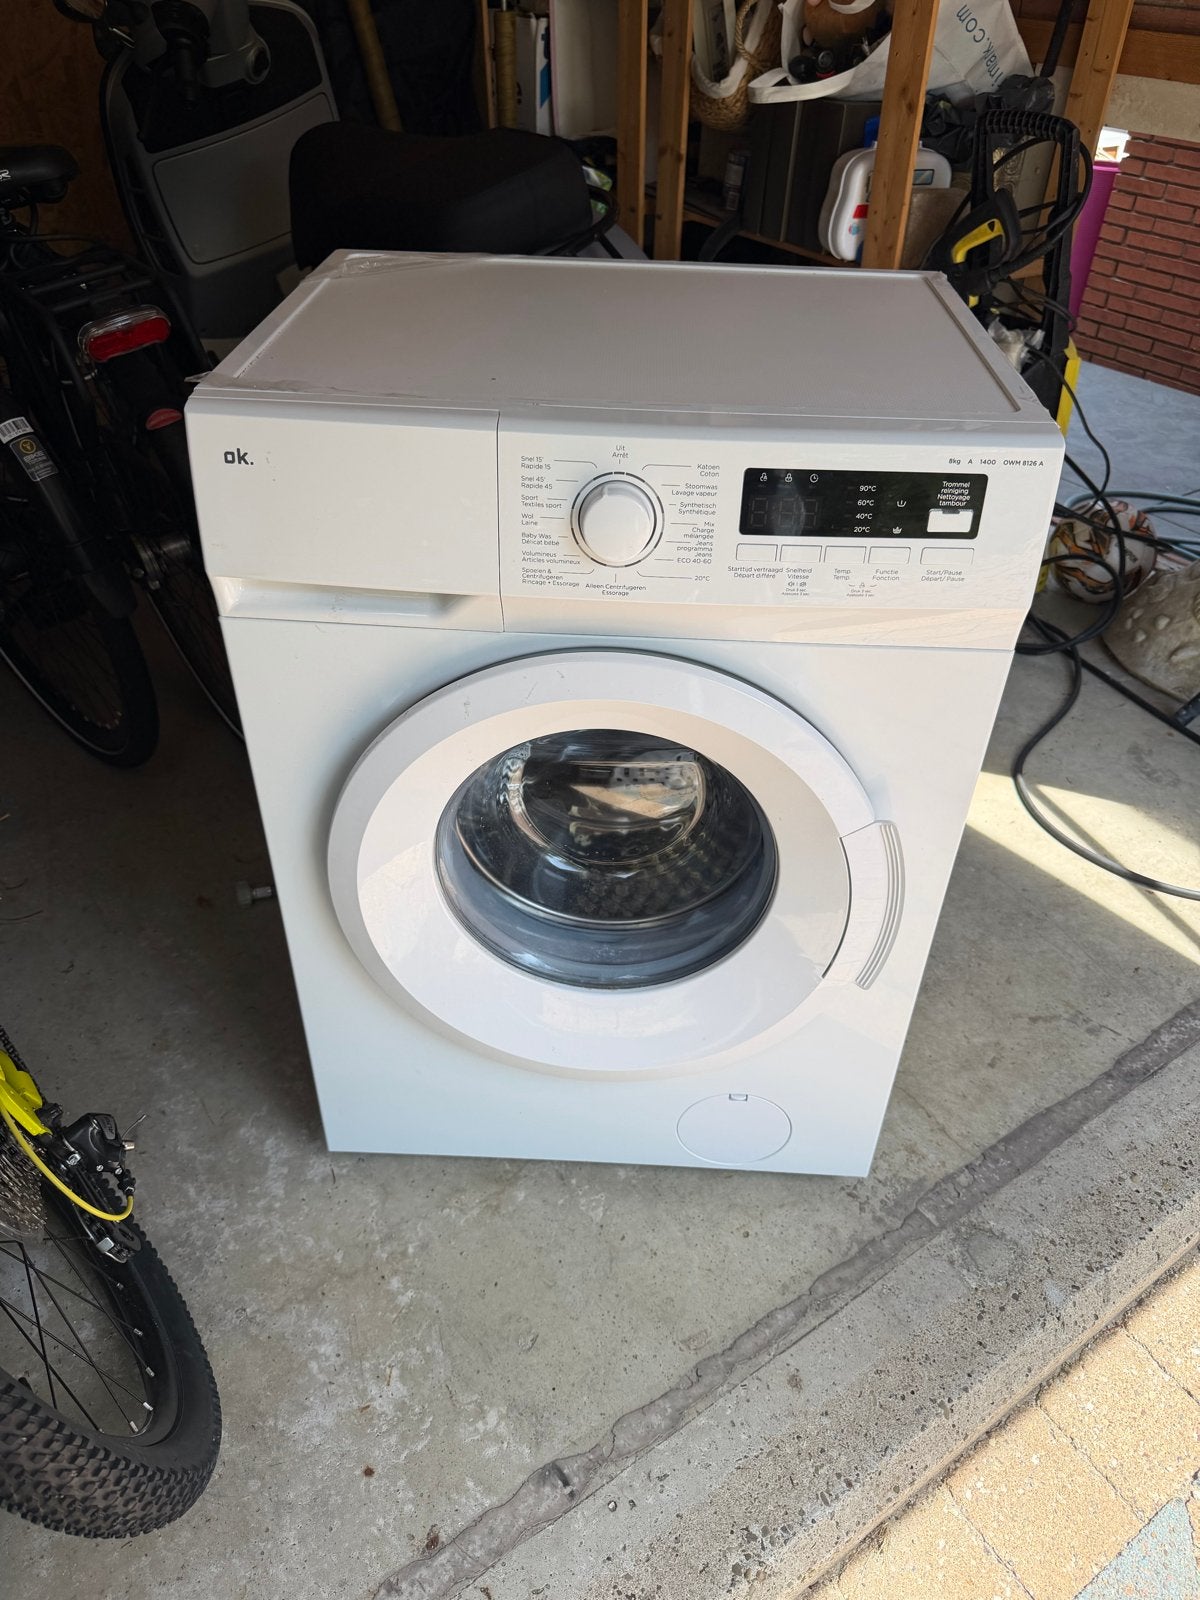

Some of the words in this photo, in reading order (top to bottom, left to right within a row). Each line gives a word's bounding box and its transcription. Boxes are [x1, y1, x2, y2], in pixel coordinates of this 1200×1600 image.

[223, 447, 254, 466] ok.
[940, 487, 969, 495] reiniging
[937, 493, 971, 501] Nettoyage
[680, 501, 717, 509] Synthetisch
[678, 508, 717, 516] Synthétique
[727, 565, 753, 573] Starttijd
[521, 573, 563, 581] Centrifugeren
[552, 580, 580, 588] Essorage
[605, 583, 647, 591] Centrifugeren
[602, 589, 629, 597] Essorage
